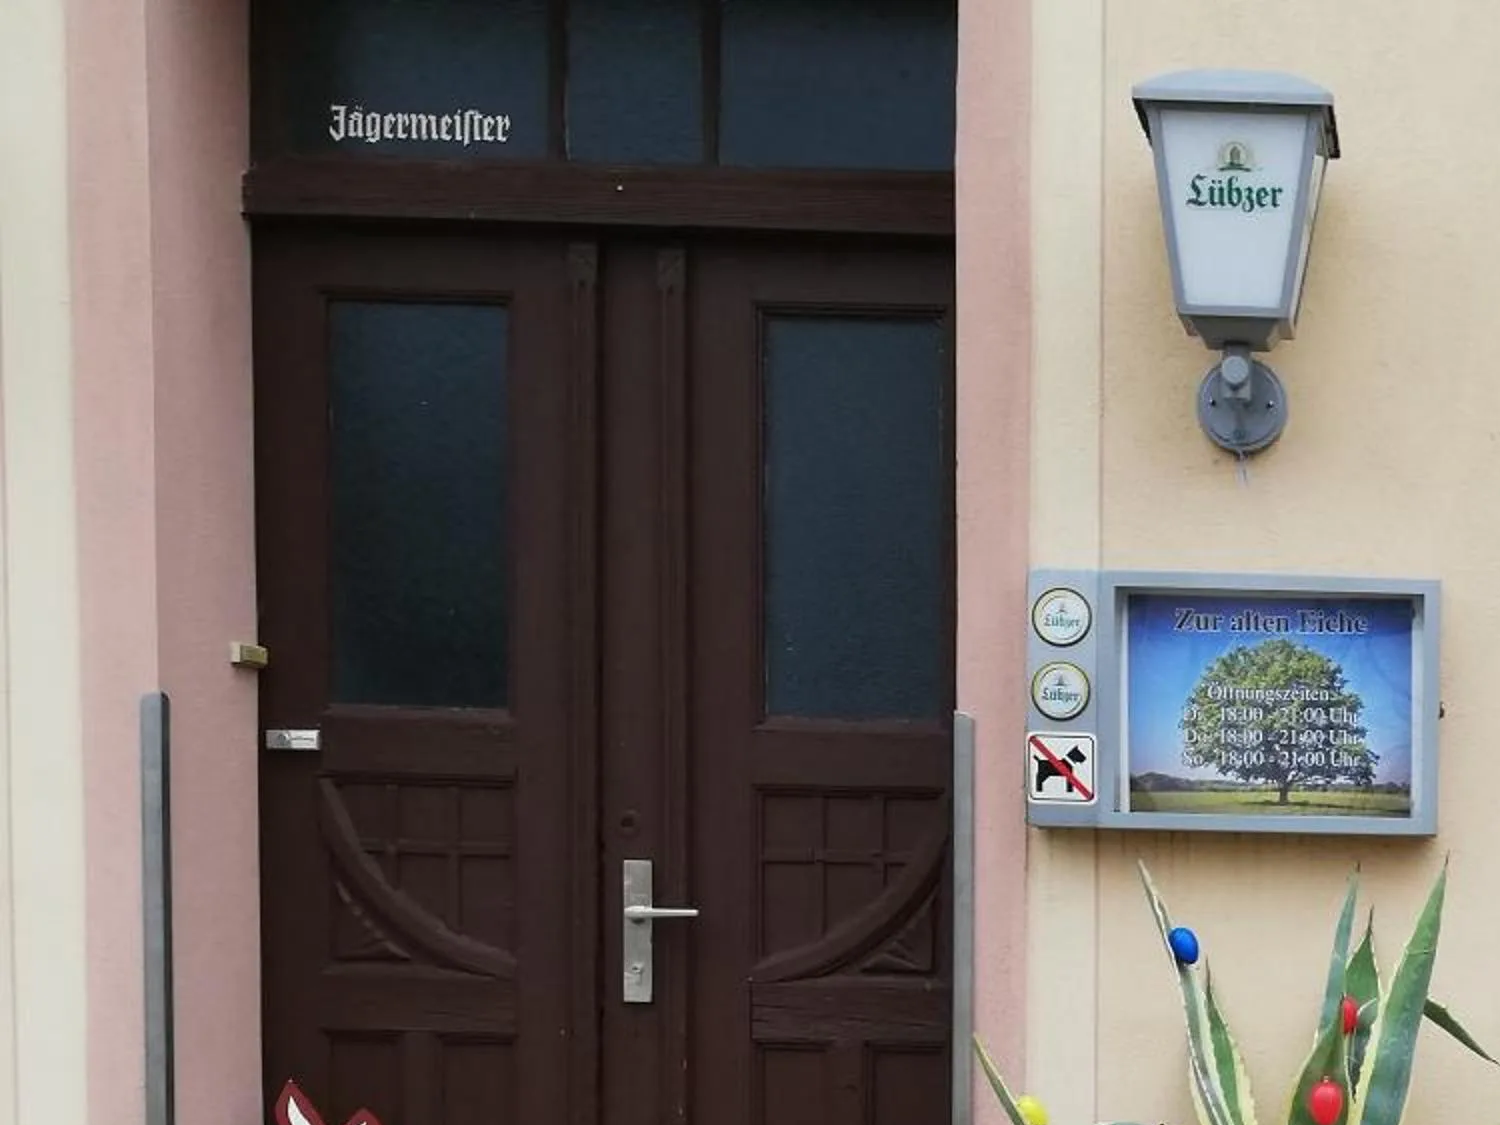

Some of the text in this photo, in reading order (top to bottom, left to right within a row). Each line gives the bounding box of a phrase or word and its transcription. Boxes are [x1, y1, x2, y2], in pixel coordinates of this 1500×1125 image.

[1186, 173, 1284, 213] Lübzer
[1174, 608, 1369, 635] Zur alten Eiche
[1330, 708, 1359, 723] Uhr
[1330, 730, 1359, 744] Uhr
[1331, 752, 1360, 767] Uhr
